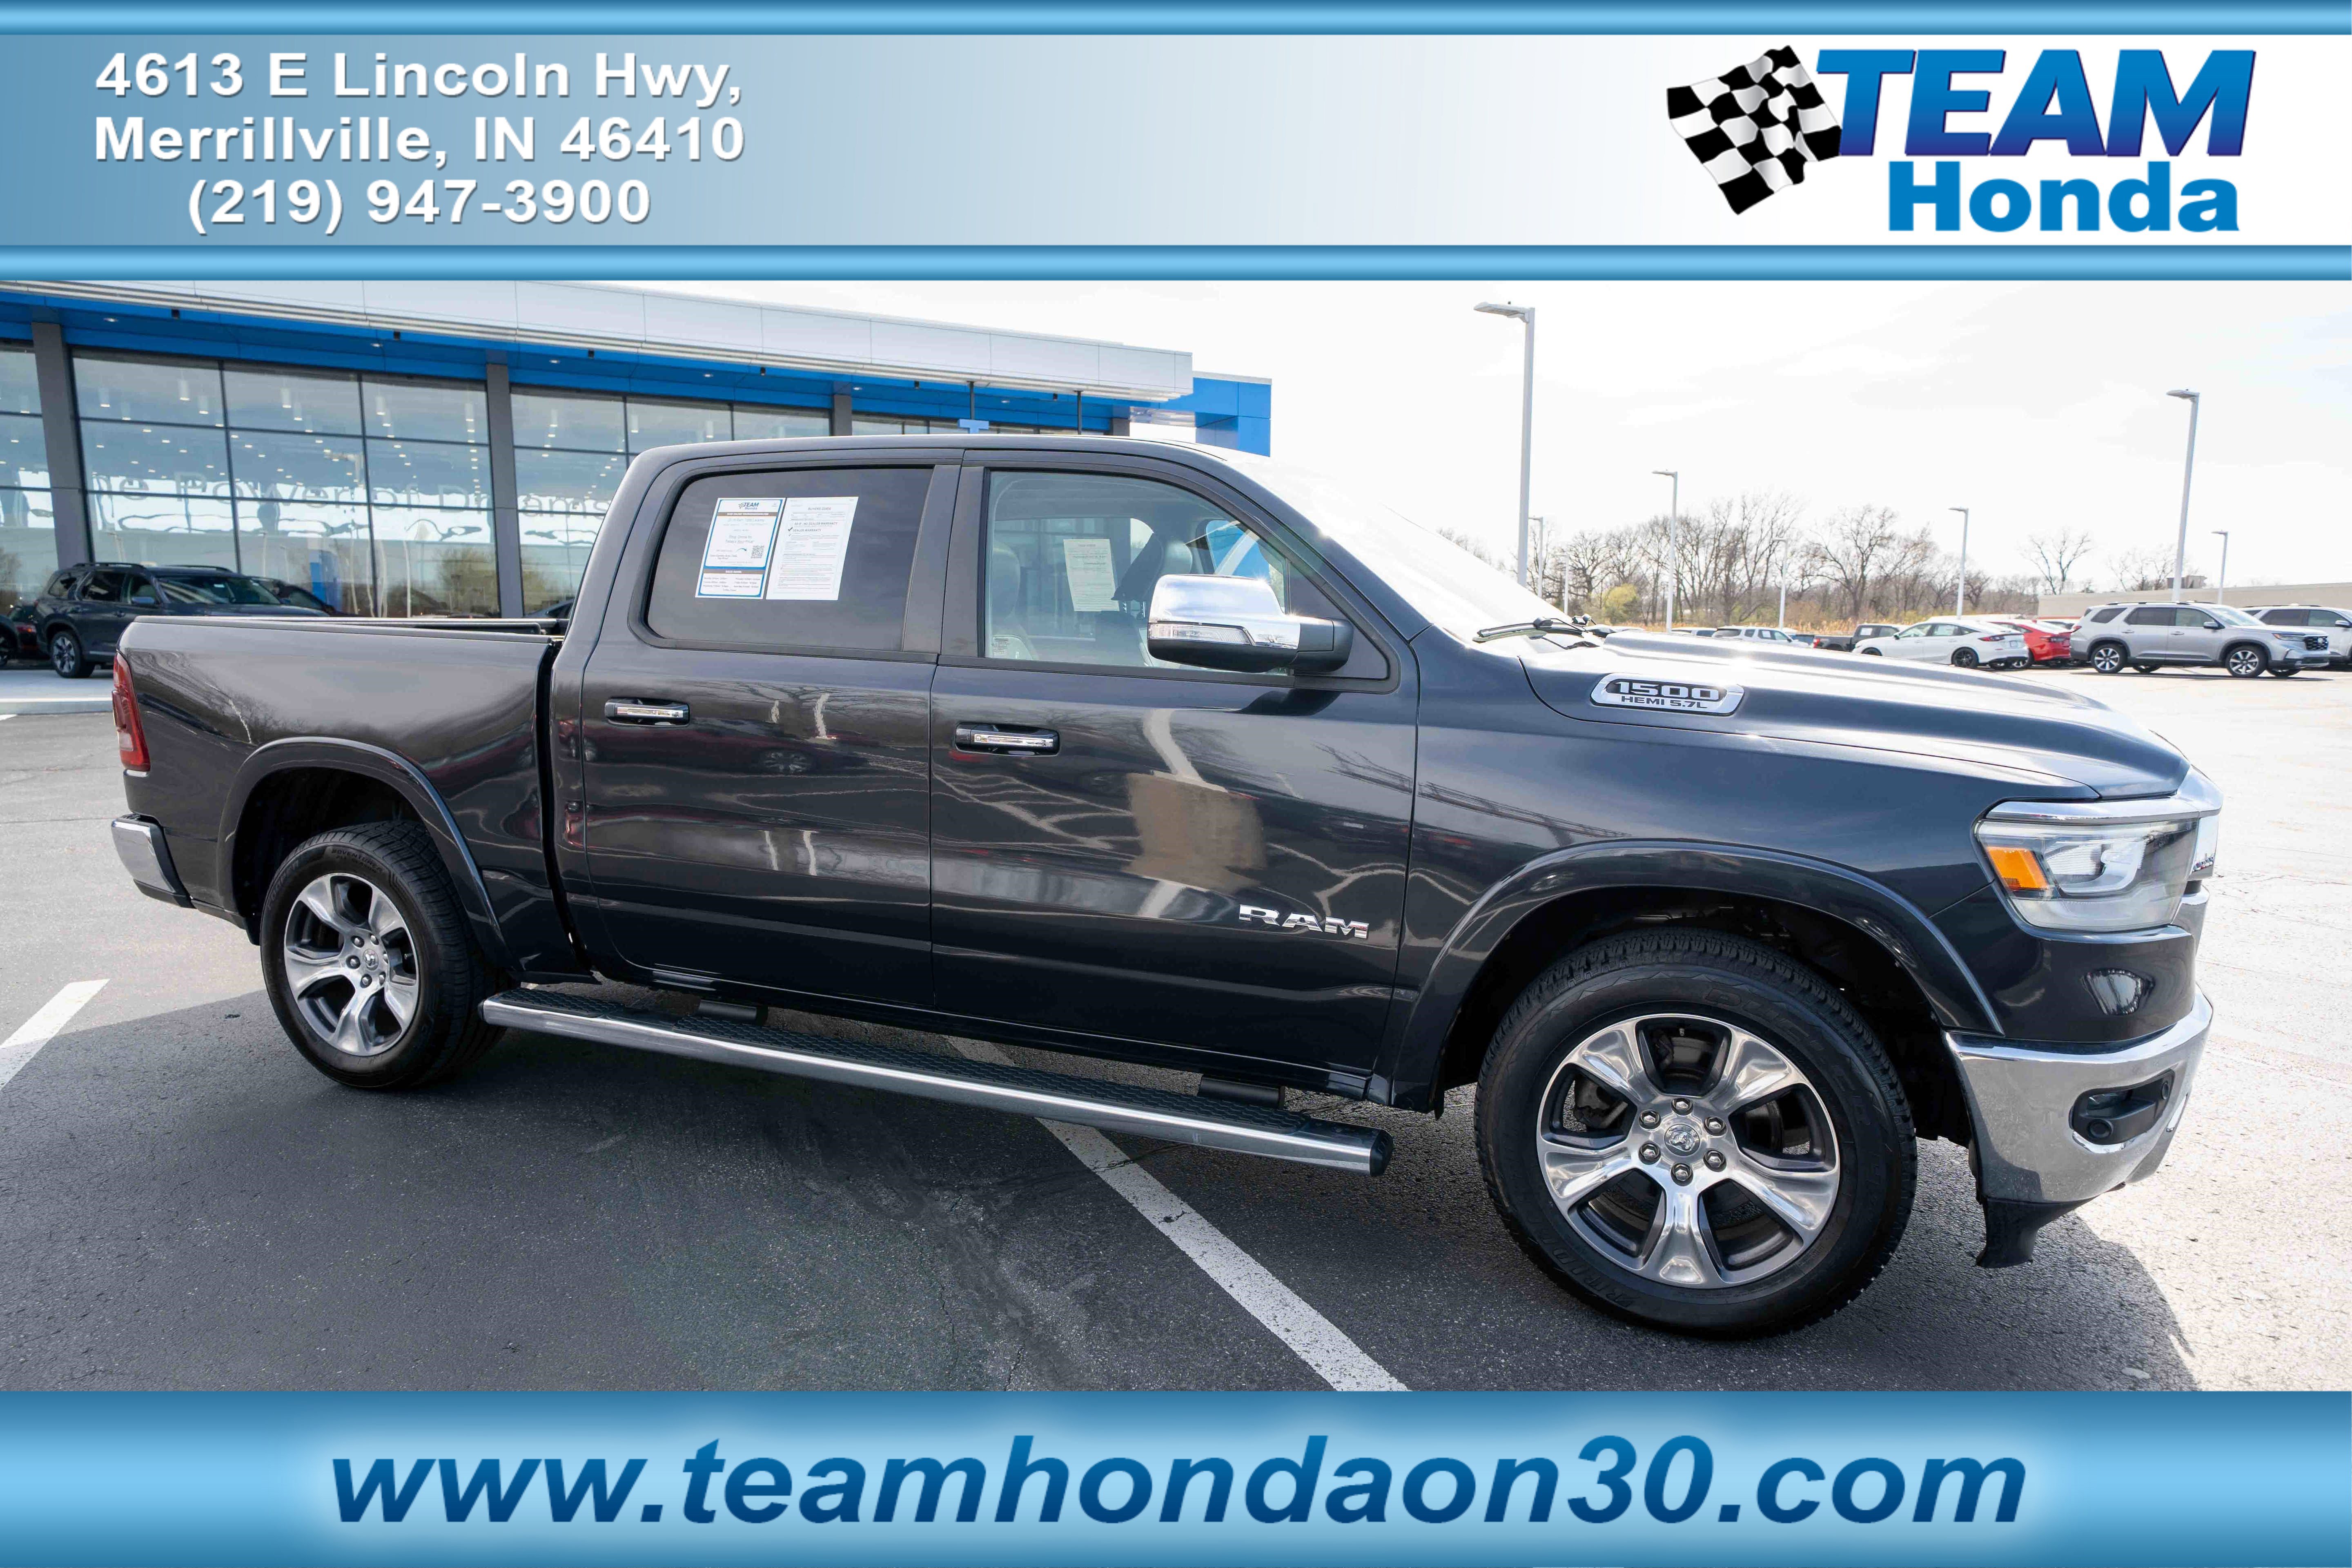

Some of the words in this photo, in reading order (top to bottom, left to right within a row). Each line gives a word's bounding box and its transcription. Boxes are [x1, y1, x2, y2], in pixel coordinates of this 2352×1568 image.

[1616, 682, 1719, 700] 1500
[1621, 696, 1665, 705] HEMI
[1670, 700, 1708, 709] 5.7L
[1239, 904, 1369, 939] RAM
